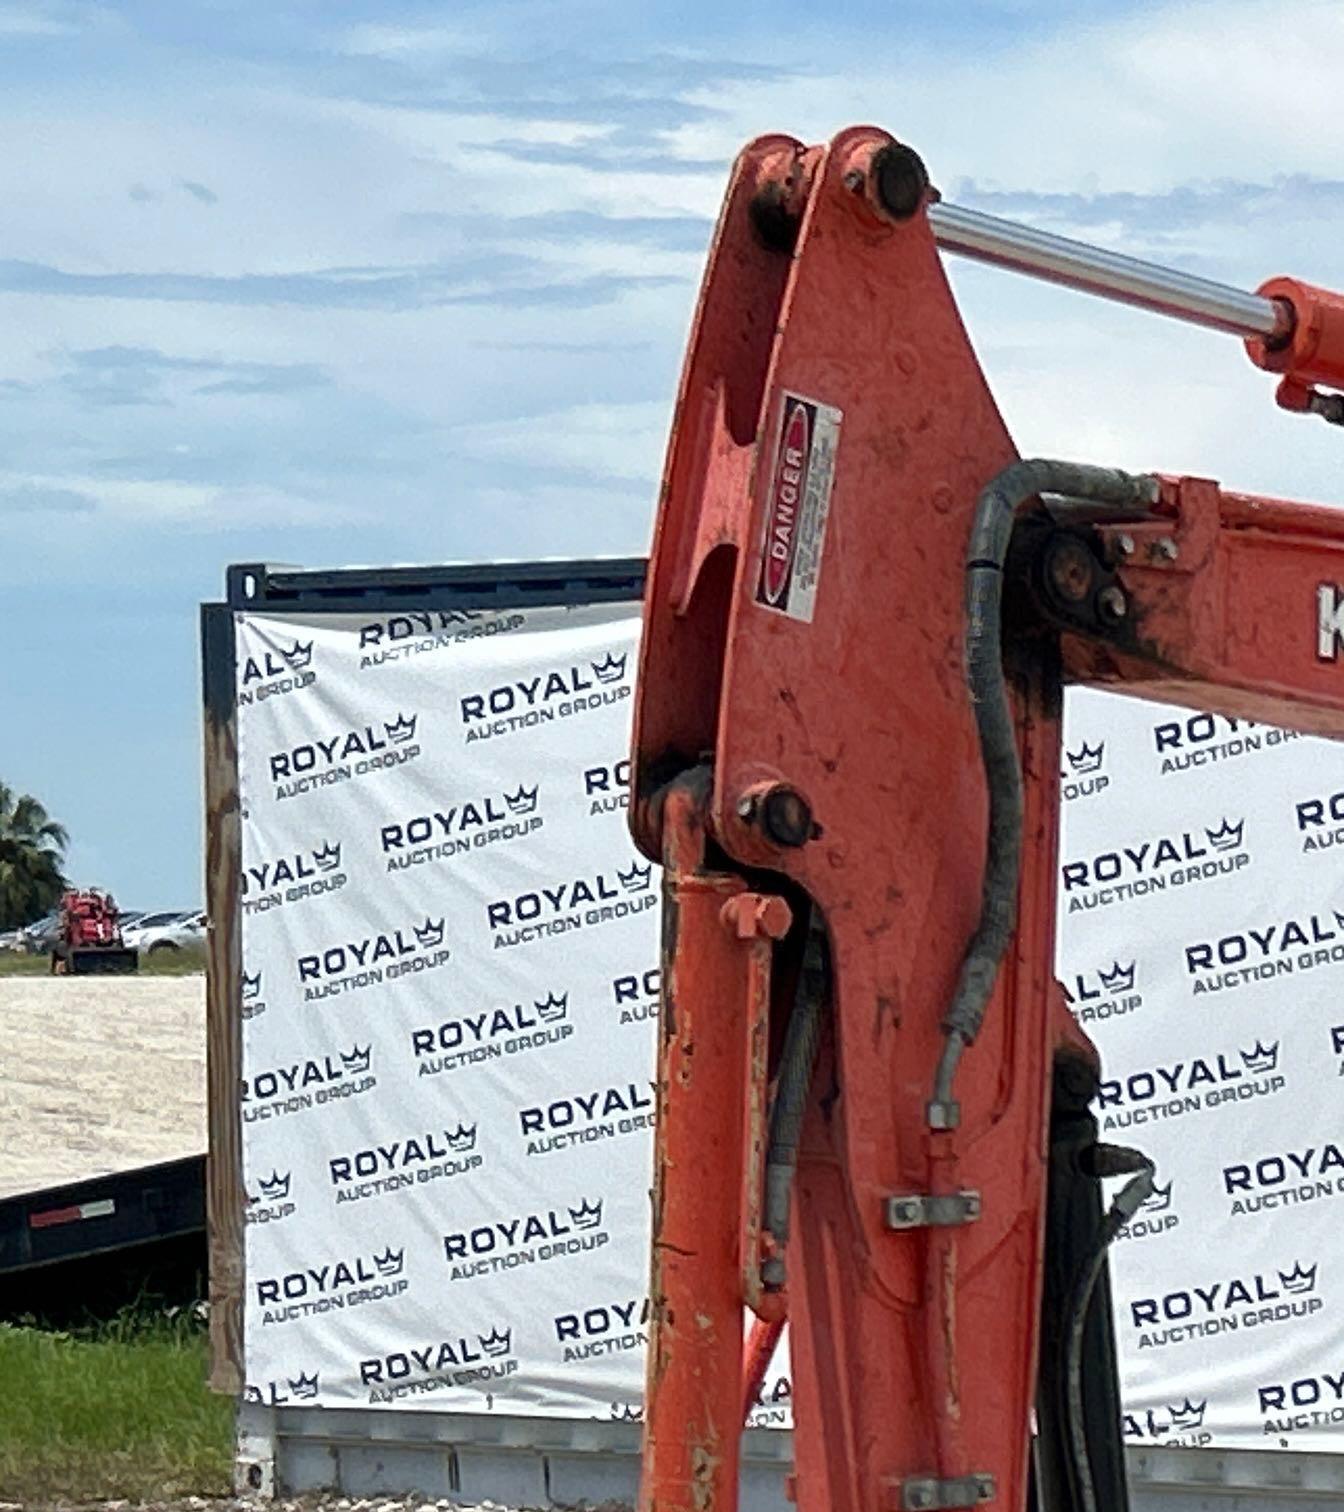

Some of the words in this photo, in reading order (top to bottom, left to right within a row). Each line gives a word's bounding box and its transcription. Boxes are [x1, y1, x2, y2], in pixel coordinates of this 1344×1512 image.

[771, 447, 803, 561] DANGER
[461, 667, 591, 723] ROYAL
[467, 708, 554, 743] AUCTION
[559, 686, 630, 717] GROUP
[270, 727, 385, 782] ROYAL
[276, 765, 351, 800] AUCTION
[355, 745, 420, 774] GROUP
[1162, 736, 1261, 774] AUCTION
[381, 798, 504, 852] ROYAL
[387, 838, 470, 872] AUCTION
[474, 817, 543, 847] GROUP
[1062, 834, 1205, 891] ROYAL
[1069, 876, 1166, 913] AUCTION
[1170, 853, 1249, 885] GROUP
[488, 876, 616, 929] ROYAL
[494, 914, 581, 949] AUCTION
[586, 895, 657, 924] GROUP
[298, 931, 413, 983] ROYAL
[1185, 916, 1332, 974] ROYAL
[305, 969, 382, 1001] AUCTION
[386, 951, 449, 978] GROUP
[1193, 958, 1293, 995] AUCTION
[412, 1005, 534, 1057] ROYAL
[419, 1044, 501, 1077] AUCTION
[505, 1025, 573, 1053] GROUP
[315, 1076, 376, 1104] GROUP
[1100, 1055, 1241, 1109] ROYAL
[1104, 1095, 1200, 1130] AUCTION
[1205, 1076, 1285, 1107] GROUP
[520, 1084, 651, 1136] ROYAL
[329, 1134, 444, 1185] ROYAL
[527, 1123, 614, 1156] AUCTION
[336, 1172, 413, 1204] AUCTION
[417, 1155, 482, 1183] GROUP
[1231, 1181, 1333, 1216] AUCTION
[444, 1212, 569, 1262] ROYAL
[451, 1249, 535, 1280] AUCTION
[538, 1232, 609, 1260] GROUP
[256, 1258, 371, 1306] ROYAL
[263, 1295, 344, 1326] AUCTION
[347, 1280, 408, 1306] GROUP
[1131, 1276, 1277, 1328] ROYAL
[1139, 1314, 1238, 1349] AUCTION
[1242, 1299, 1322, 1327] GROUP
[360, 1338, 480, 1386] ROYAL
[368, 1374, 453, 1404] AUCTION
[455, 1360, 518, 1387] GROUP
